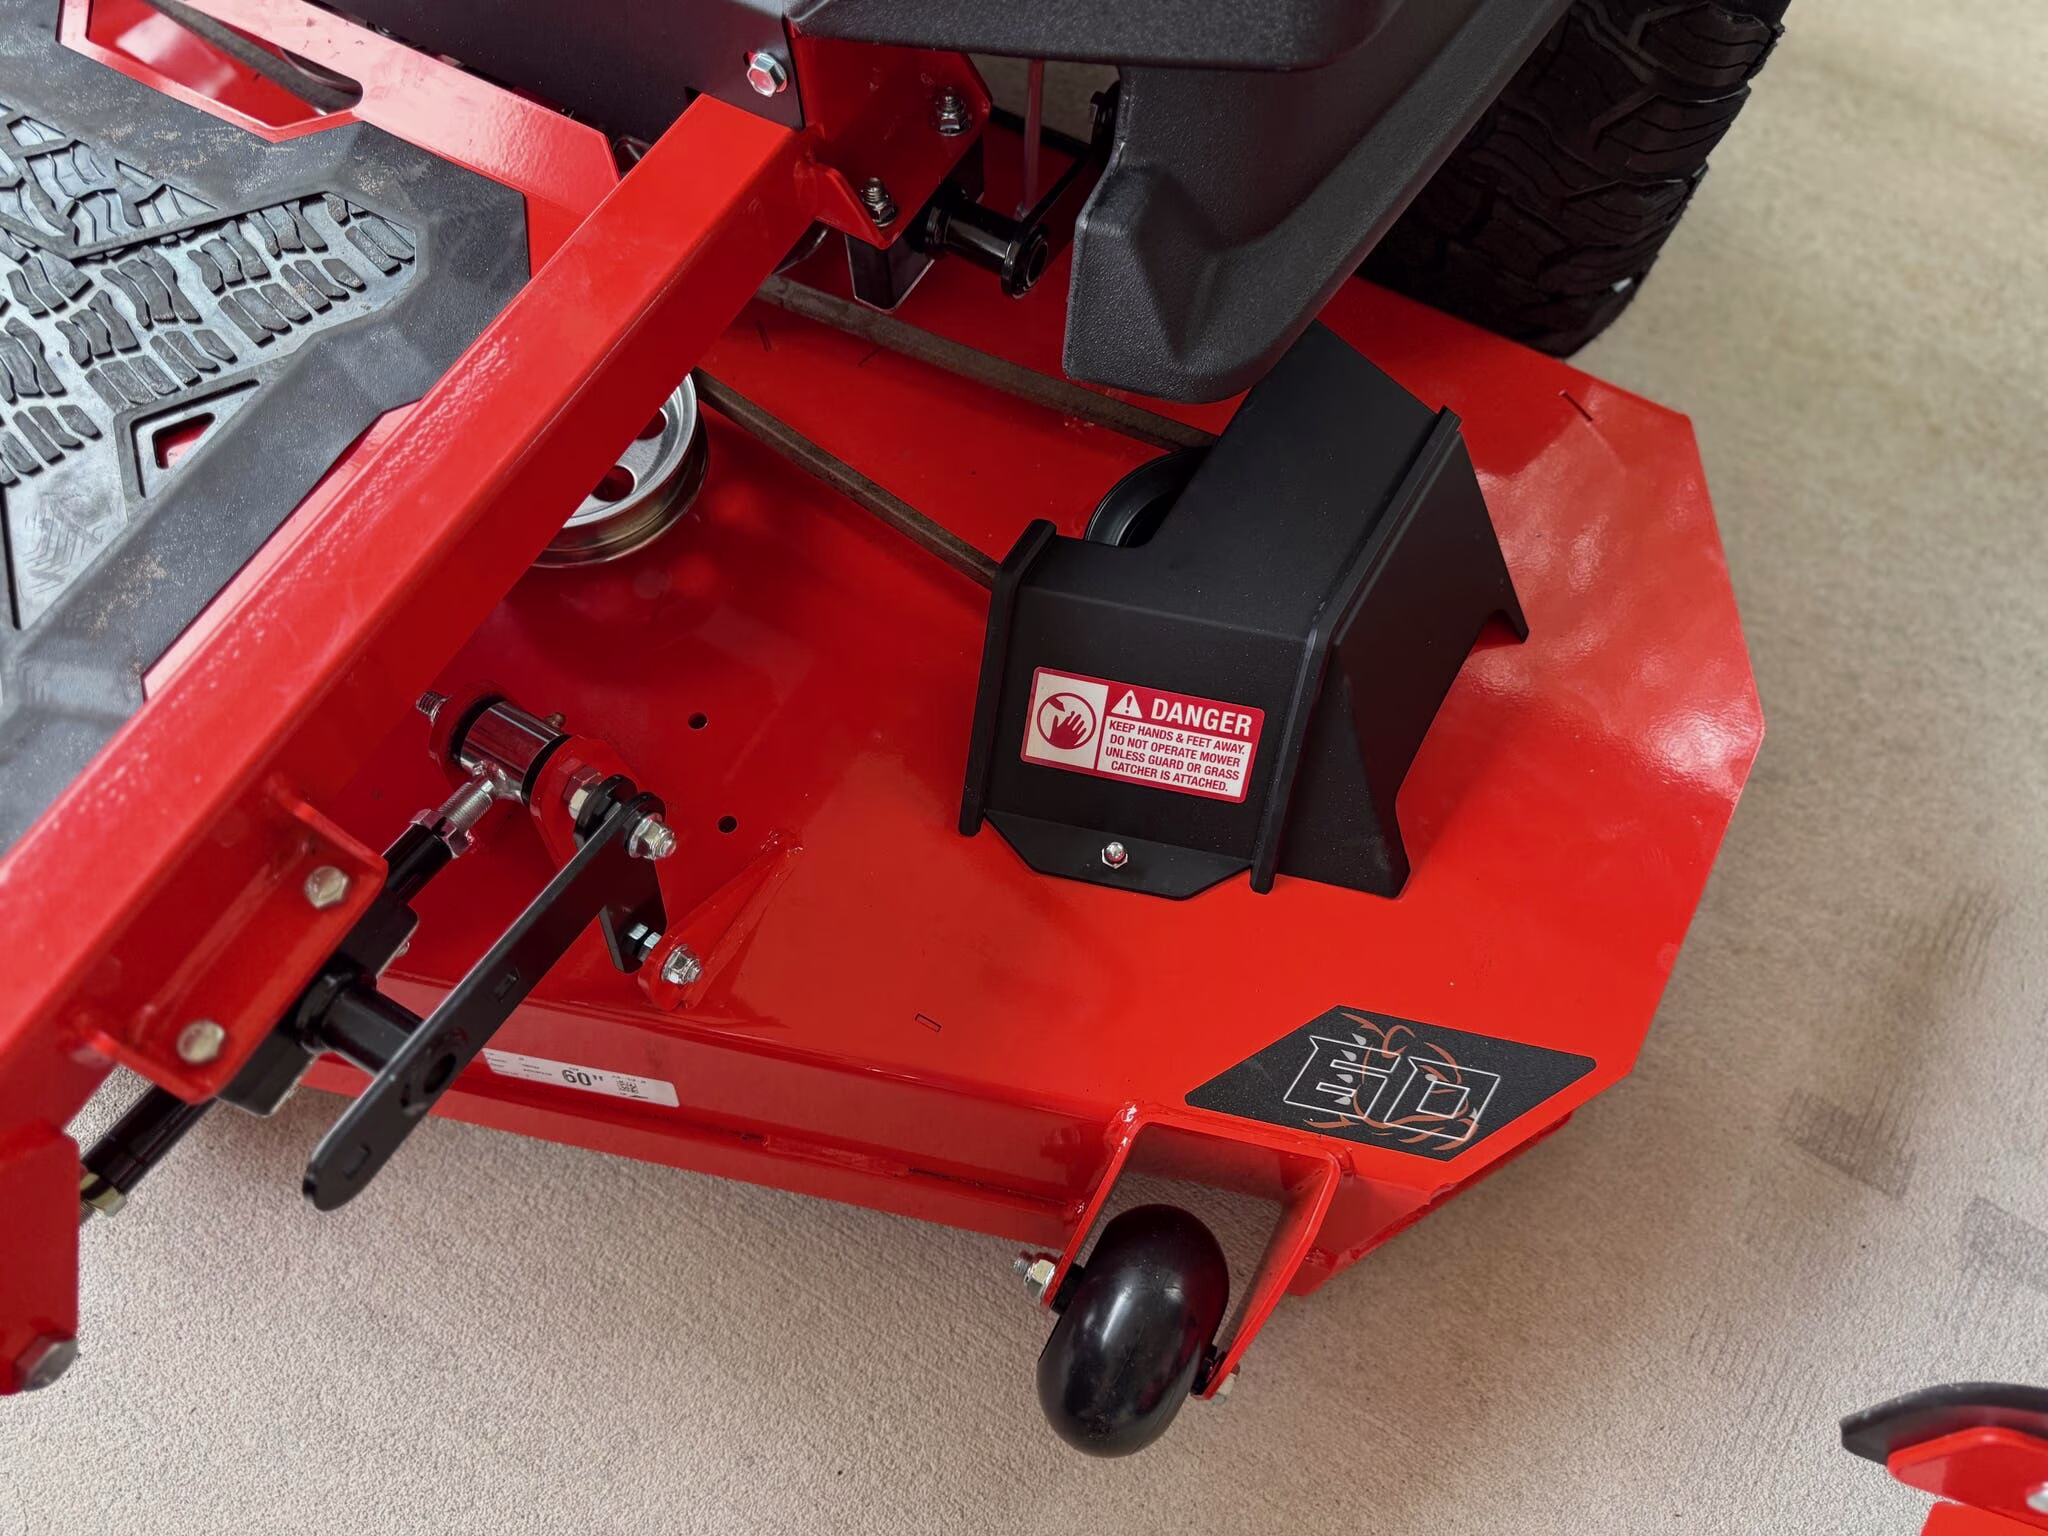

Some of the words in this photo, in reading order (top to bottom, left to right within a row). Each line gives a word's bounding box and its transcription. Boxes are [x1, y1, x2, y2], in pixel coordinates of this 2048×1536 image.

[1150, 698, 1252, 737] DANGER
[1109, 720, 1136, 734] KEEP
[1137, 725, 1174, 742] HANDS
[1175, 733, 1184, 743] &
[1186, 734, 1212, 749] FEET
[1213, 740, 1245, 756] AWAY.
[1110, 734, 1125, 746] DO
[1127, 737, 1149, 750] NOT
[1150, 742, 1197, 760] OPERATE
[1199, 751, 1241, 768] MOWER
[1105, 746, 1146, 764] UNLESS
[1148, 755, 1184, 770] GUARD
[1186, 762, 1202, 774] OR
[1204, 765, 1240, 781] GRASS
[1111, 760, 1158, 779] CATCHER
[1160, 770, 1171, 781] IS
[1172, 773, 1228, 792] ATTACHED.
